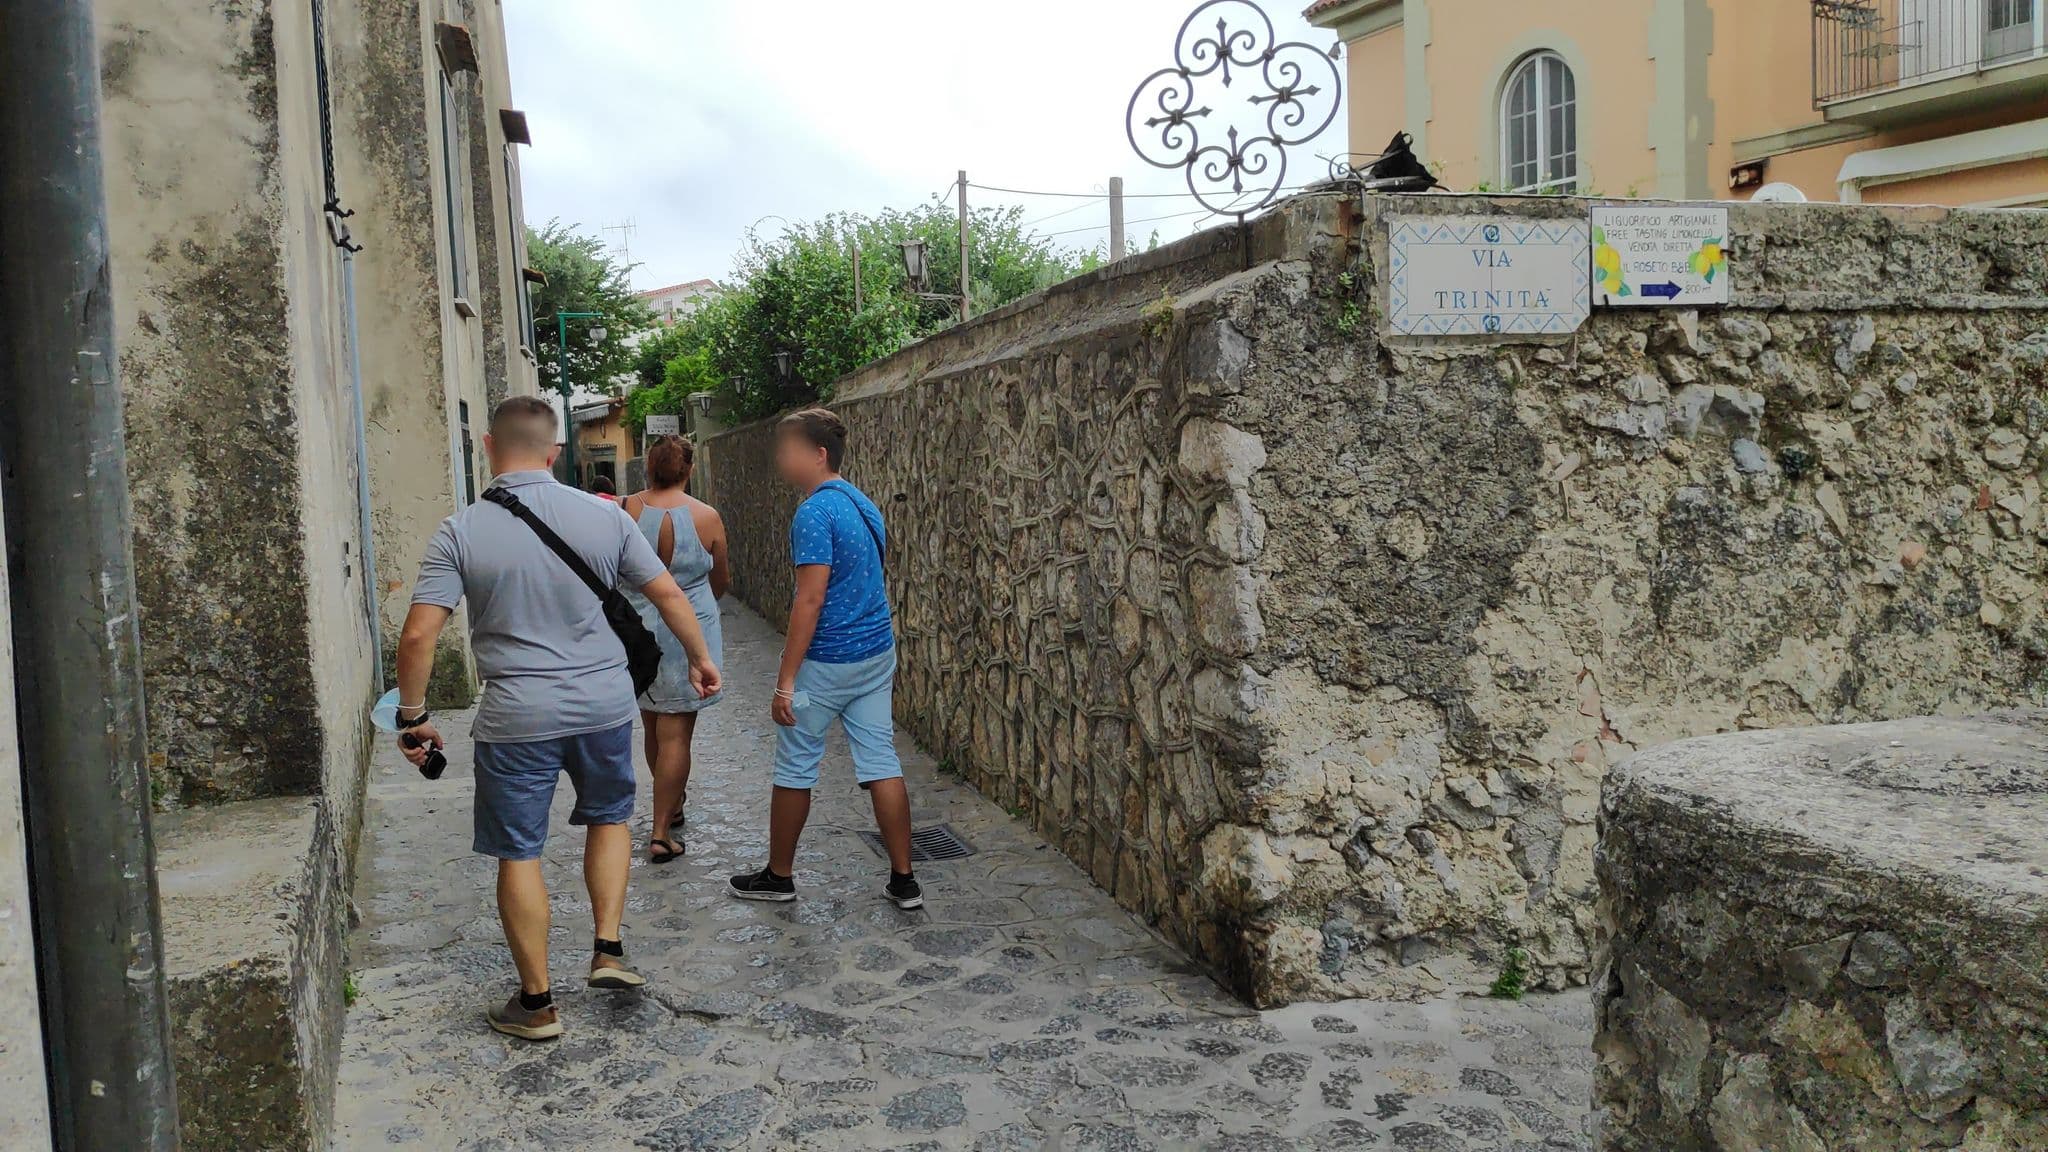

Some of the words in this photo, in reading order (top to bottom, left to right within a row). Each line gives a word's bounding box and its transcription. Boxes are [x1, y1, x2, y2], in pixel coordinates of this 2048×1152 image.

[1606, 229, 1628, 240] FREE
[1635, 228, 1667, 239] TASTING
[1672, 228, 1713, 239] LIMONCELLO
[1663, 241, 1693, 252] DIRETTA
[1472, 249, 1512, 267] VIA
[1623, 263, 1630, 273] IL
[1633, 262, 1667, 273] ROSETO
